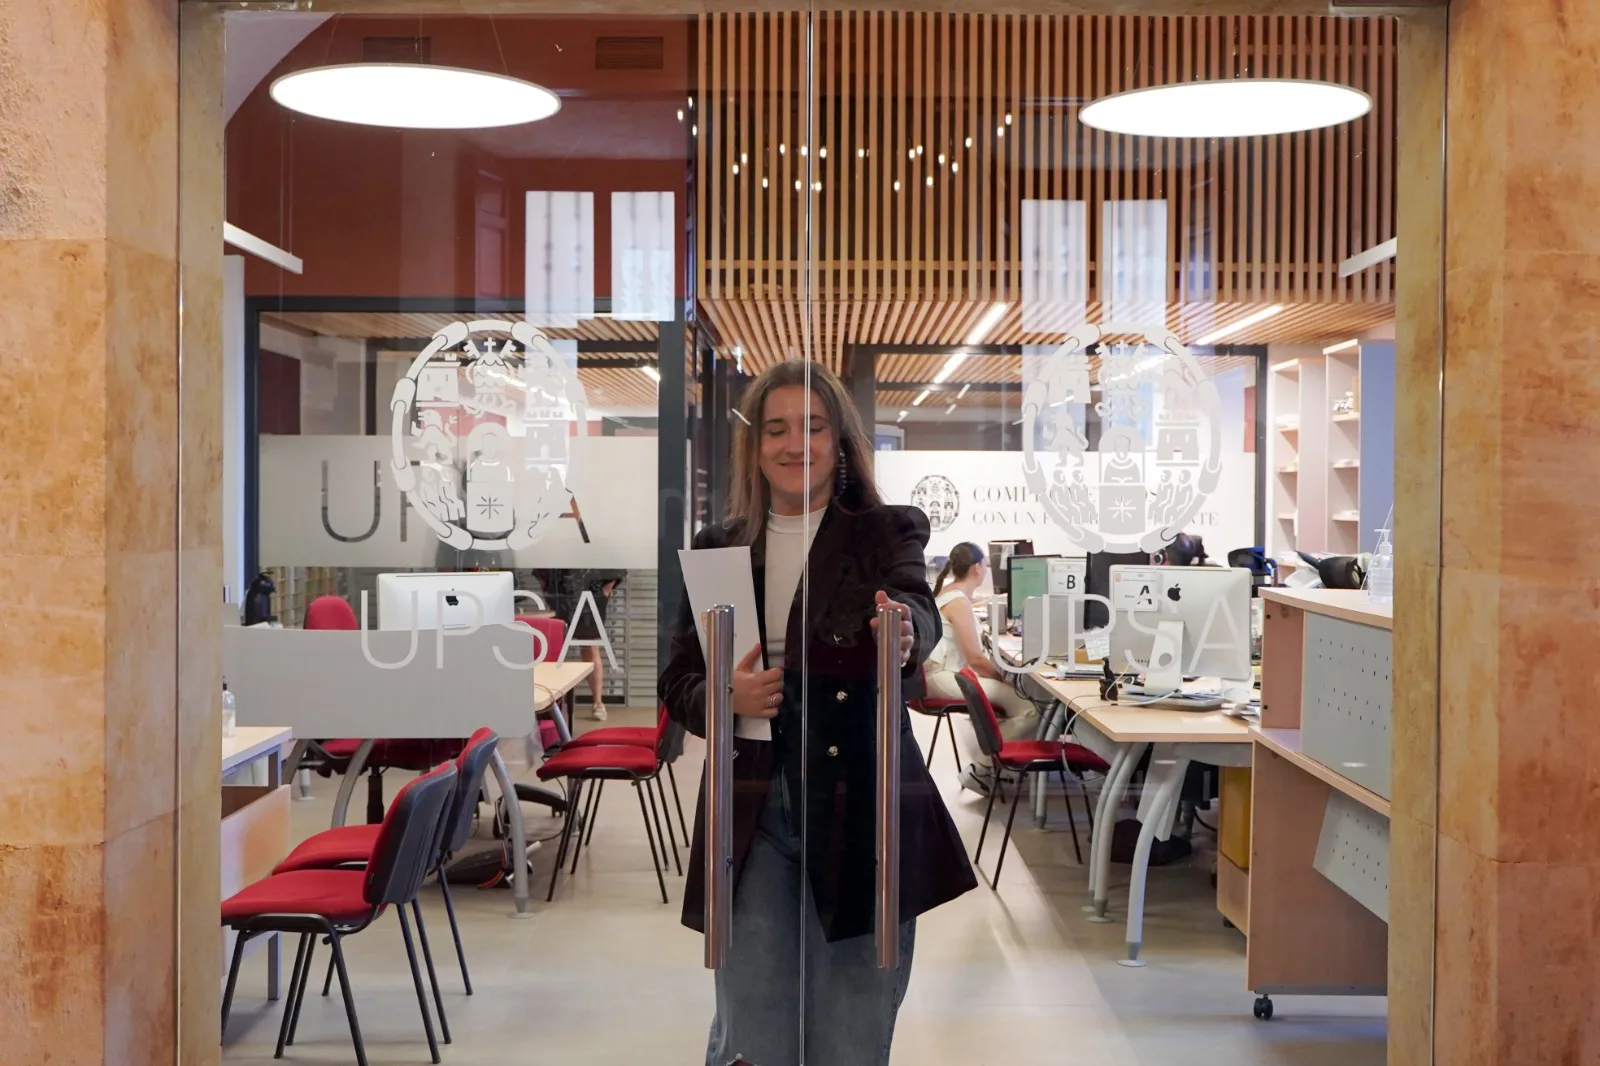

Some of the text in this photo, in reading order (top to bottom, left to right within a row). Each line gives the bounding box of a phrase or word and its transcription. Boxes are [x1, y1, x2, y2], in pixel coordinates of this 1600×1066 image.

[972, 511, 1007, 525] CON
[1014, 511, 1036, 525] UN
[1066, 574, 1076, 590] B
[1137, 585, 1152, 605] A
[360, 590, 620, 669] UPSA
[990, 593, 1252, 674] UPSA
